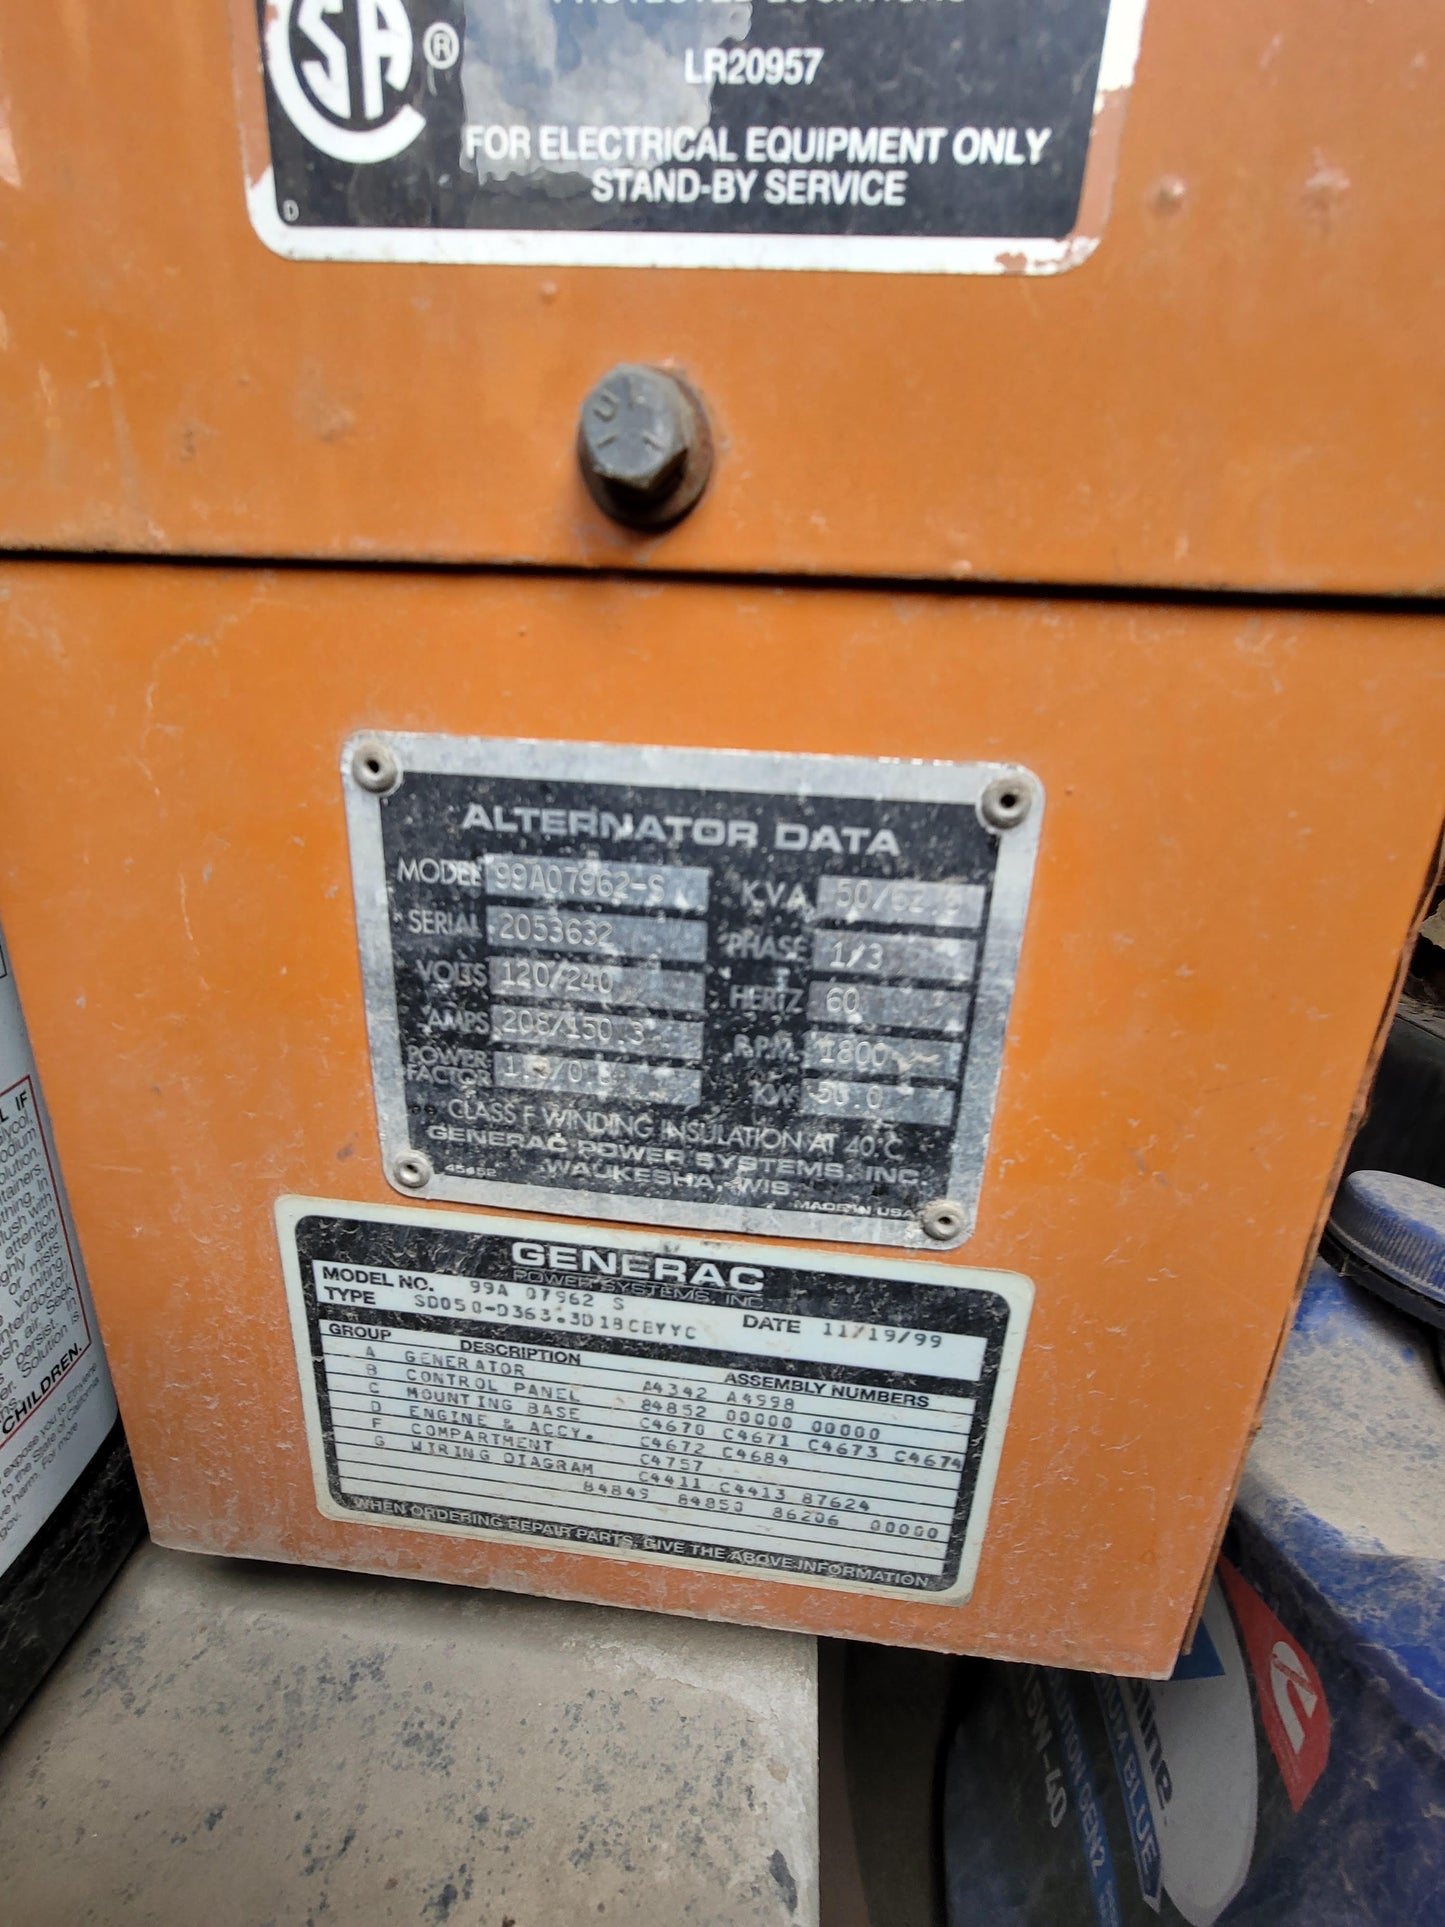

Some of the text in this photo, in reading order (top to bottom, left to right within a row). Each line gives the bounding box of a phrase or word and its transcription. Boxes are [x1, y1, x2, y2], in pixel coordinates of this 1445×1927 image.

[684, 47, 825, 85] LR20957
[466, 125, 1052, 166] FOR ELECTRICAL EQUIPMENT ONLY
[592, 168, 906, 207] STAND-BY SERVICE
[462, 803, 900, 857] ALTERNATOR DATA
[495, 862, 666, 902] 99A07962-S
[741, 879, 808, 908] KVA
[408, 910, 613, 946] SERIAL 2053632
[829, 941, 884, 970] 1/3
[415, 960, 613, 994] VOLTS 120/240
[729, 984, 861, 1015] HERTZ 60
[427, 1009, 490, 1036] AMPS
[817, 1036, 889, 1067] 1800
[15, 1091, 27, 1111] IF
[449, 1099, 516, 1124] CLASS
[541, 1107, 654, 1136] WINDING
[660, 1116, 801, 1150] INSULATION
[808, 1132, 839, 1152] AT
[428, 1124, 570, 1153] GENERAC
[577, 1139, 685, 1165] POWER
[877, 1207, 915, 1219] USA
[322, 1265, 395, 1287] MODEL
[399, 1274, 435, 1293] NO.
[469, 1280, 509, 1297] 99A
[511, 1241, 765, 1292] GENERAC
[512, 1268, 596, 1289] POWER
[9, 1276, 22, 1295] or
[323, 1286, 377, 1305] TYPE
[328, 1323, 392, 1342] GROUP
[742, 1314, 943, 1349] DATE 11/19/99
[22, 1324, 68, 1379] Solution
[365, 1345, 377, 1359] A
[404, 1350, 526, 1377] GENERATOR
[460, 1339, 582, 1366] DESCRIPTION
[2, 1342, 82, 1435] CHILDREN.
[366, 1363, 881, 1441] B CONTROL PANEL 84852 00000 00000
[724, 1372, 931, 1409] ASSEMBLY NUMBERS
[368, 1381, 964, 1471] C MOUNTING BASE C4670 C4671 C4673 C4674
[371, 1400, 382, 1413] D
[409, 1405, 489, 1429] ENGINE
[530, 1421, 594, 1441] ACCY.
[639, 1435, 705, 1455] C4672
[372, 1417, 704, 1473] F COMPARTMENT C4757
[374, 1435, 386, 1448] G
[410, 1440, 491, 1462] WIRING
[504, 1453, 595, 1475] DIAGRAM
[801, 1492, 870, 1513] 87624
[354, 1497, 408, 1514] WHEN
[411, 1504, 503, 1529] ORDERING
[508, 1518, 573, 1538] REPAIR
[643, 1537, 685, 1555] GIVE
[690, 1544, 726, 1560] THE
[730, 1549, 793, 1571] ABOVE
[797, 1558, 929, 1588] INFORMATION
[870, 1519, 939, 1540] 00000
[1123, 1752, 1157, 1876] BLUE
